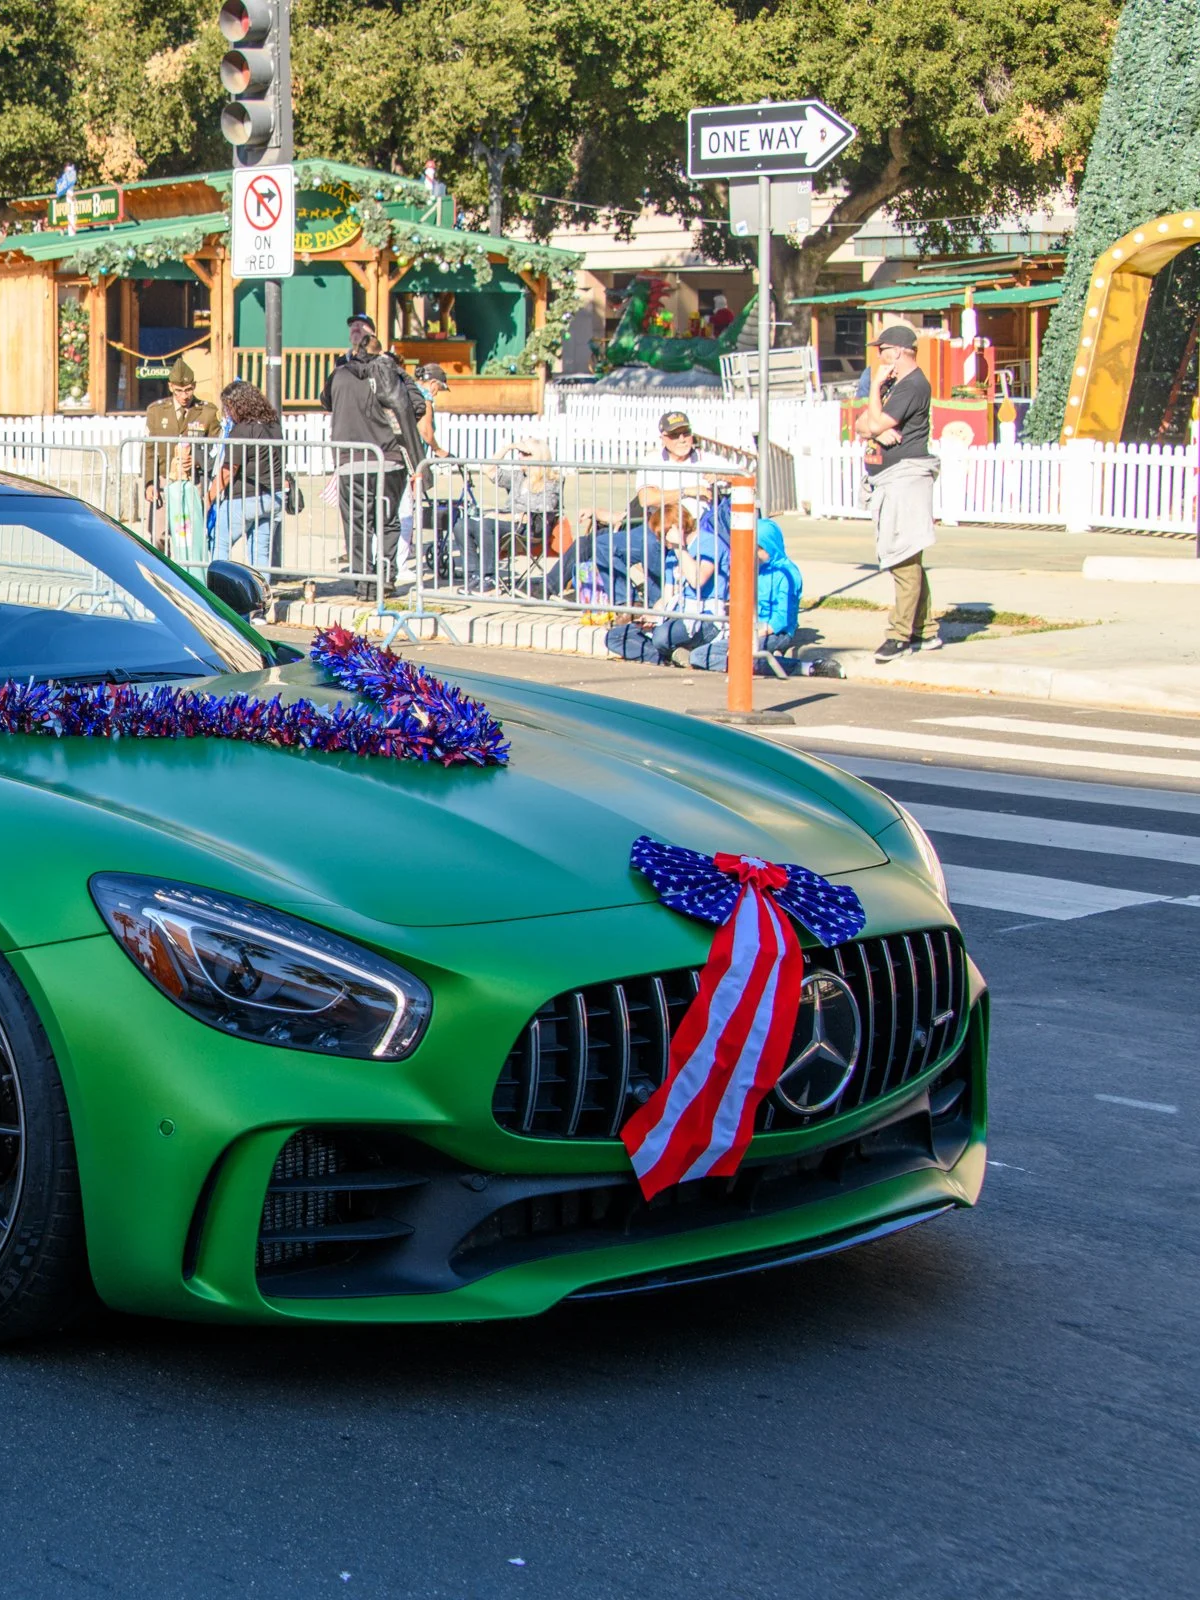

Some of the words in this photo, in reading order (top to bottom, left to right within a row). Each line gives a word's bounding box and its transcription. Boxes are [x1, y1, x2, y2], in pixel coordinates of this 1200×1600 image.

[708, 129, 750, 154] ONE
[759, 125, 803, 151] WAY
[52, 199, 93, 225] INFORATION
[92, 192, 116, 218] BOOTH
[254, 235, 271, 250] ON
[315, 215, 356, 249] PARK
[249, 254, 275, 271] RED
[140, 367, 170, 378] CLOSED
